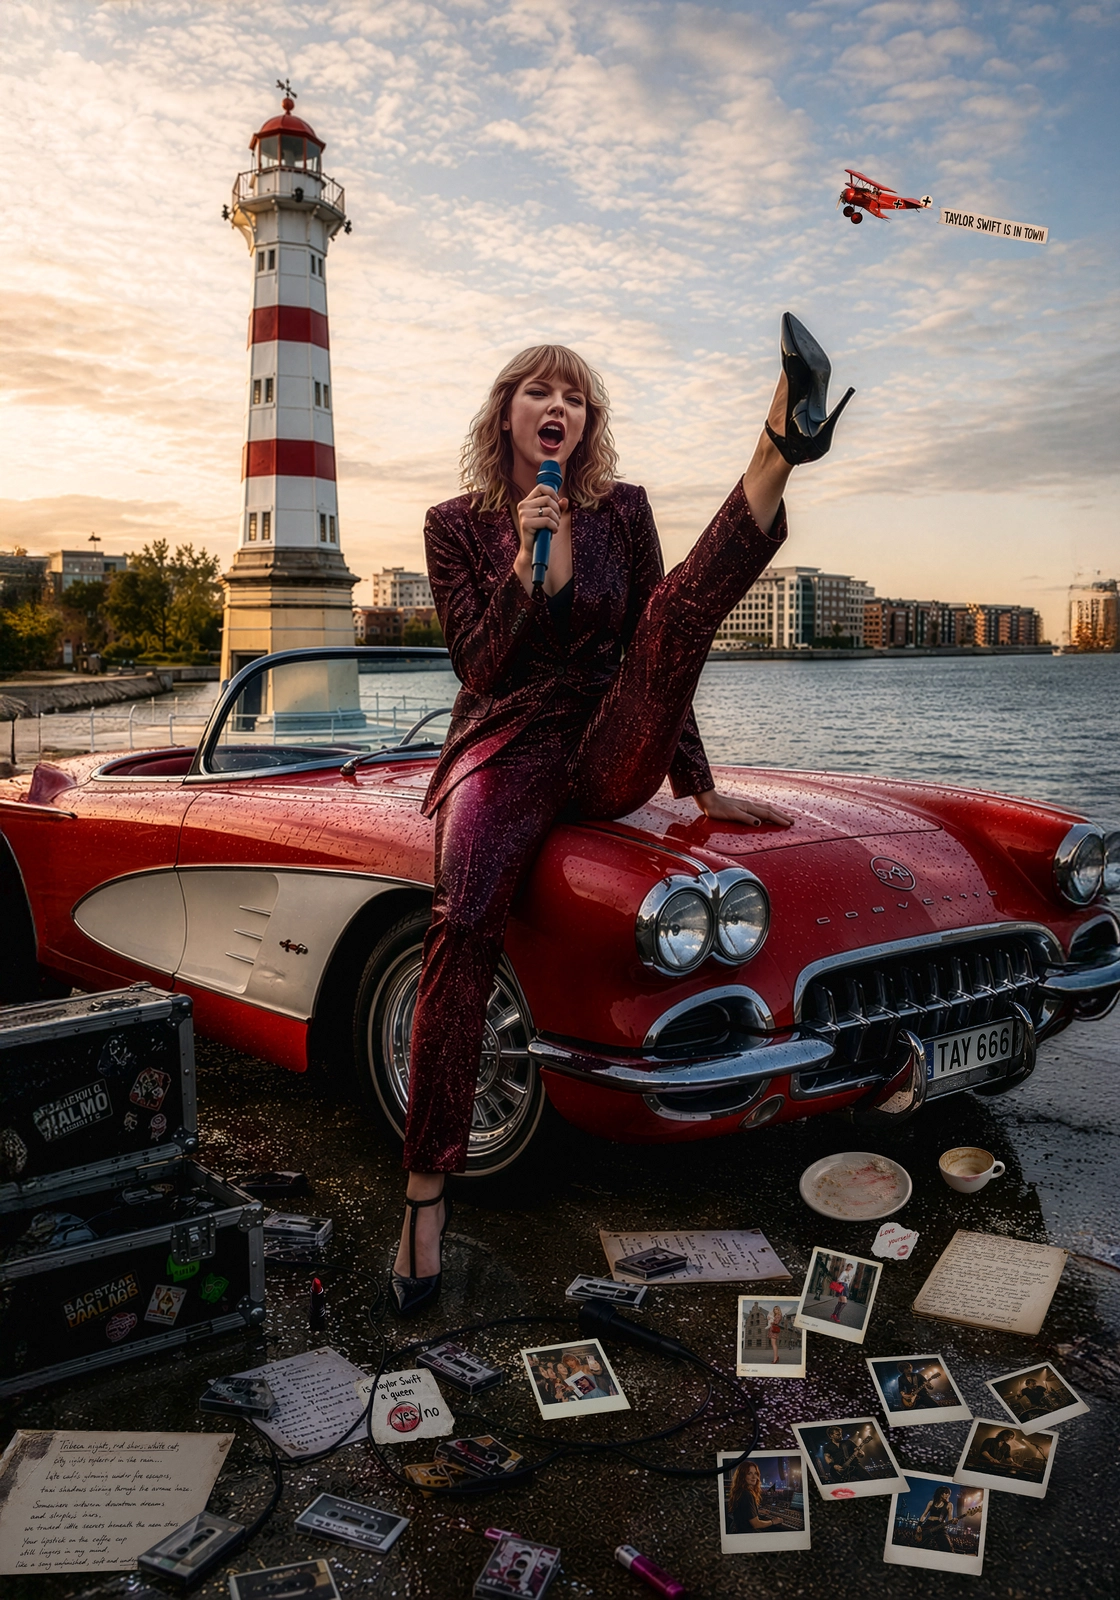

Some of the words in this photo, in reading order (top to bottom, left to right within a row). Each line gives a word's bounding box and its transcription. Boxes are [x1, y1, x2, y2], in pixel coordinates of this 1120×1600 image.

[944, 211, 974, 228] TAYLOR
[977, 218, 1002, 233] SWIFT
[1003, 224, 1011, 235] IS
[1013, 226, 1022, 237] IN
[1024, 228, 1044, 241] TOWN
[927, 1065, 932, 1076] S
[938, 1036, 972, 1072] TAY
[977, 1028, 1009, 1062] 666
[880, 1228, 895, 1237] Love
[362, 1386, 372, 1394] is
[399, 1374, 422, 1386] Swift
[391, 1388, 415, 1402] queen
[60, 1440, 84, 1450] Tribeca
[147, 1441, 166, 1450] white
[59, 1485, 87, 1493] shadows
[105, 1500, 137, 1508] downtown
[30, 1511, 46, 1520] and
[82, 1522, 105, 1530] secrets
[135, 1520, 146, 1528] the
[22, 1537, 38, 1548] Your
[41, 1536, 66, 1548] lipstick
[92, 1534, 111, 1546] coffee
[115, 1537, 128, 1545] cup
[20, 1548, 35, 1557] still
[39, 1548, 61, 1558] lingers
[15, 1560, 28, 1569] like
[38, 1561, 52, 1570] song
[92, 1558, 106, 1567] soft
